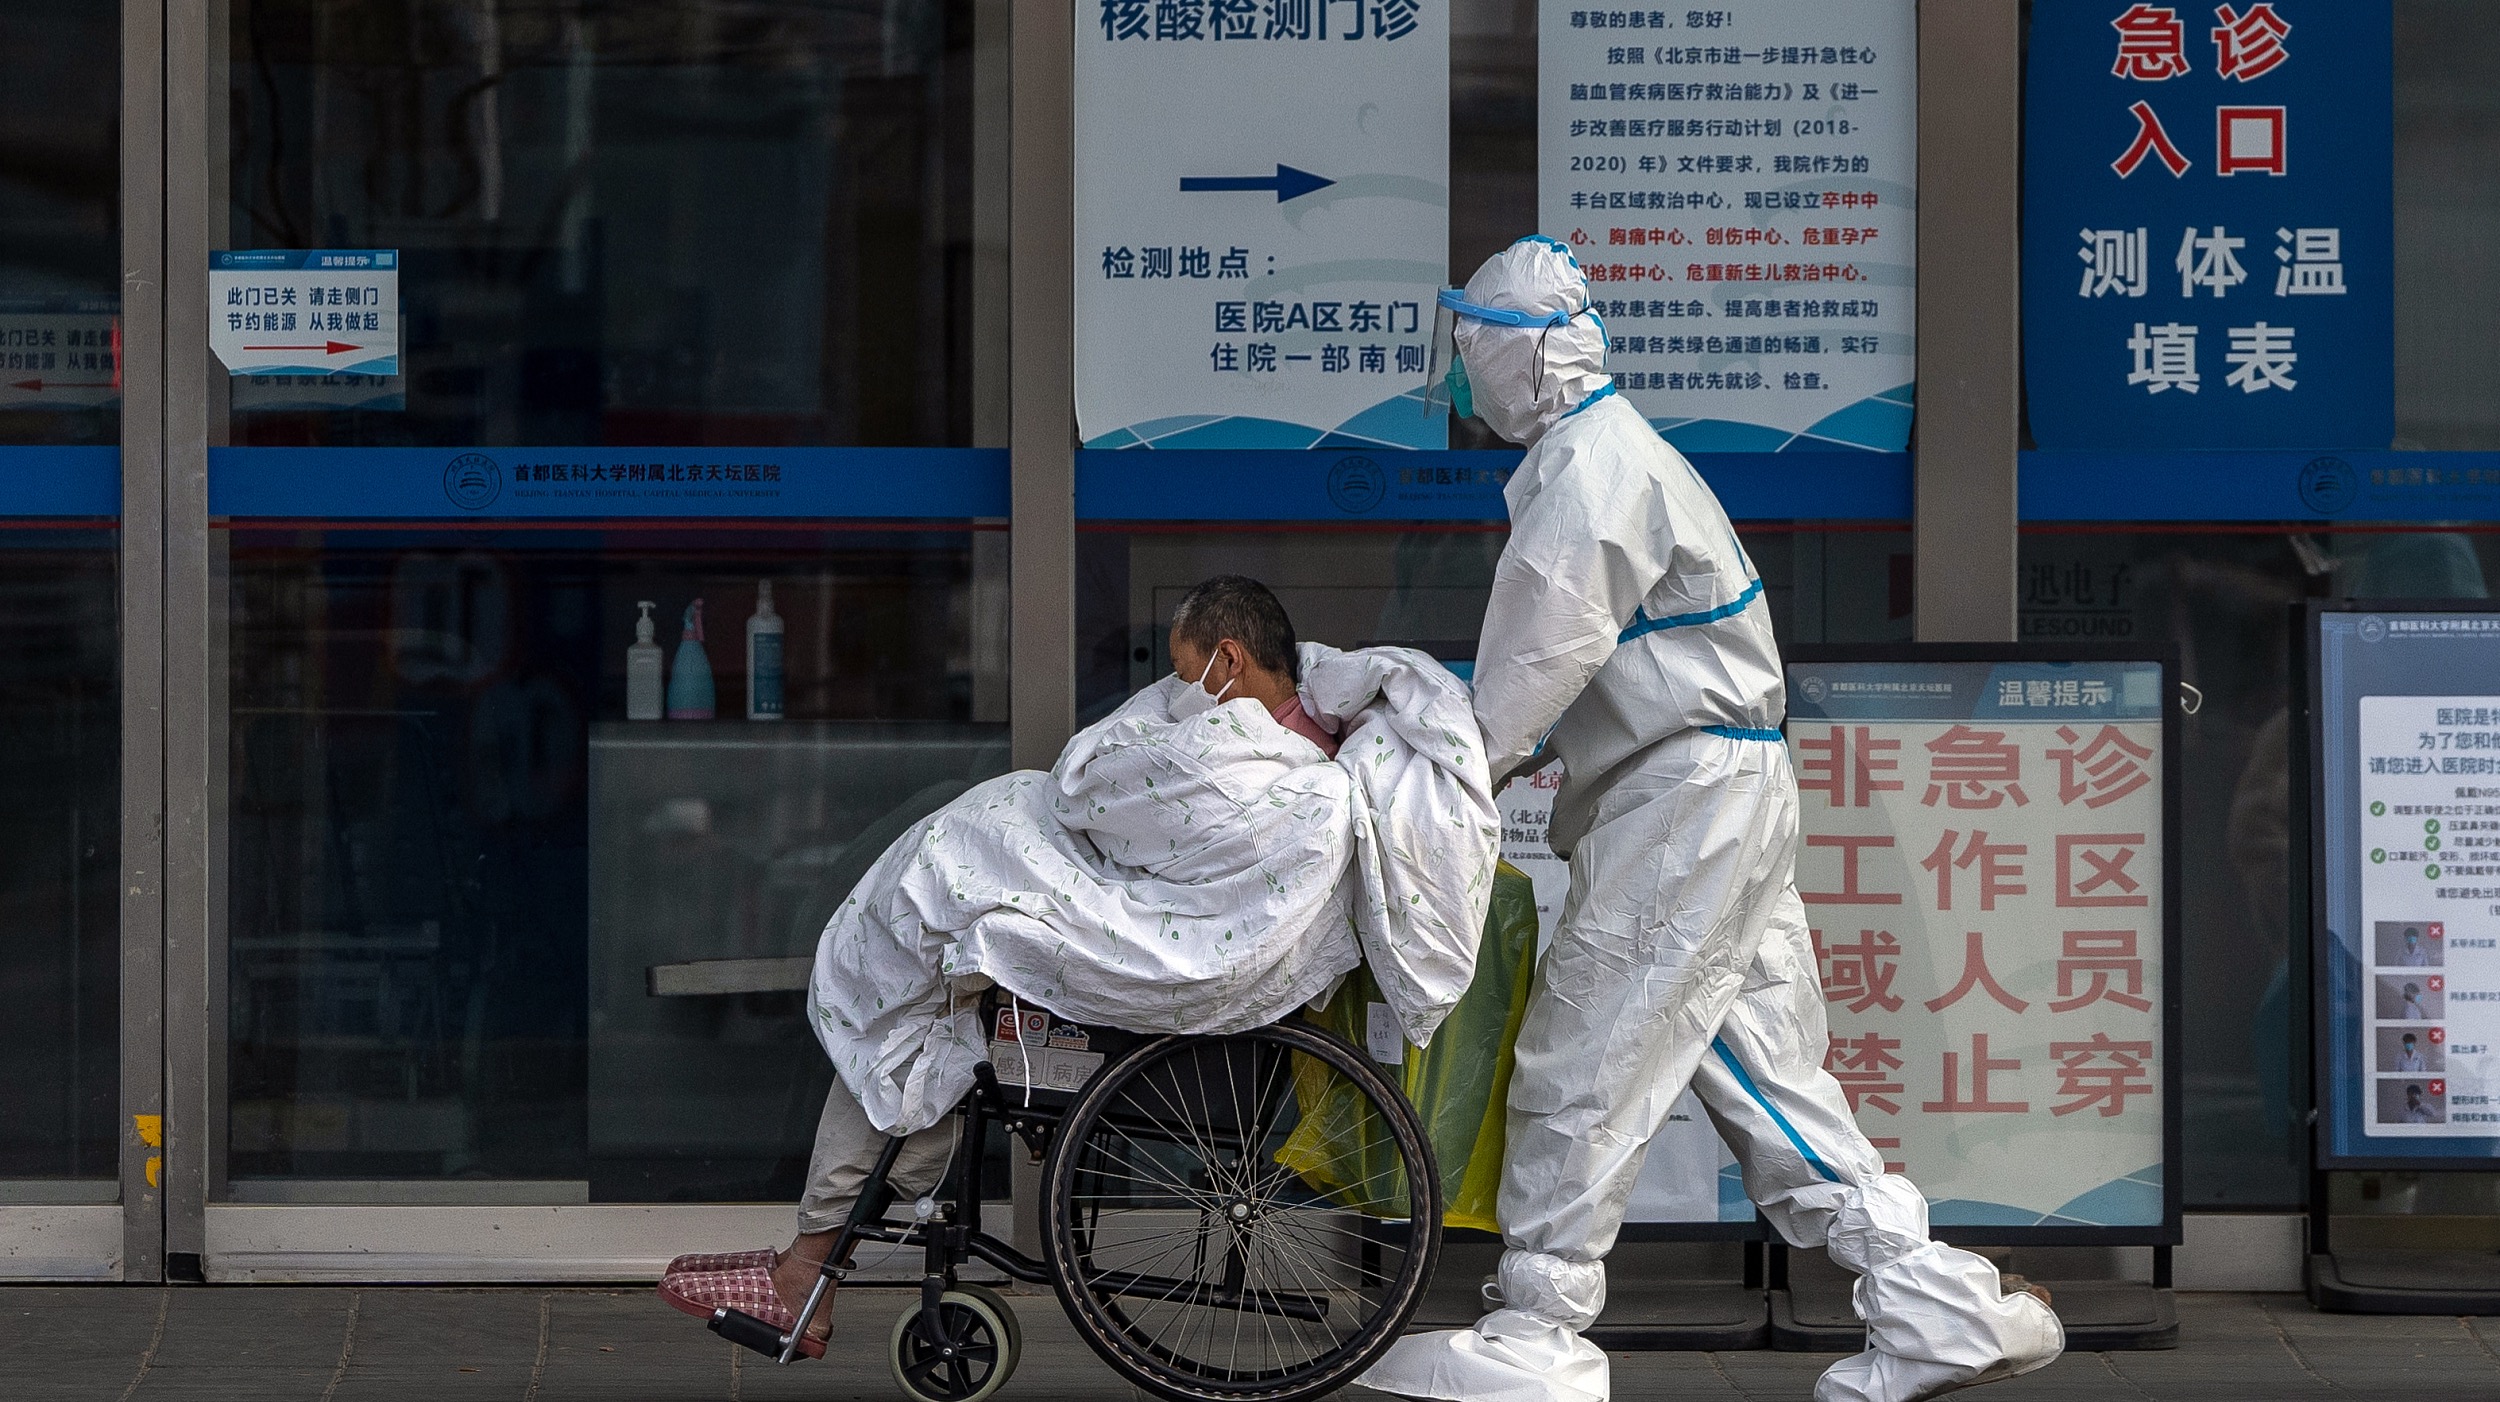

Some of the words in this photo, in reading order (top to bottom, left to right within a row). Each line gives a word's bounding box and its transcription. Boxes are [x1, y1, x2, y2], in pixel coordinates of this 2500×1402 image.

[1100, 0, 1421, 41] 核酸检测门诊
[1570, 11, 1733, 28] 尊敬的患者，您好！
[1608, 47, 1877, 65] 按照《北京市进一步提升急性心
[2110, 3, 2292, 82] 急诊
[1570, 83, 1878, 101] 脑血管疾病医疗救治能力》及《进一
[2110, 100, 2287, 179] 入口
[1570, 191, 1878, 210] 丰台区域救治中心，现已设立卒中中
[1570, 228, 1878, 246] 心、胸痛中心、创伤中心、危重孕产
[1102, 246, 1275, 279] 检测地点：
[2078, 226, 2347, 298] 测体温
[227, 287, 297, 306] 此门已关
[309, 287, 379, 306] 请走侧门
[227, 312, 297, 331] 节约能源
[309, 312, 379, 331] 从我做起
[1215, 301, 1418, 333] 医院A区东门
[1211, 342, 1425, 373] 住院一部南侧
[2127, 322, 2297, 394] 填表
[1600, 372, 1829, 390] 通道患者优先就诊、检查。
[513, 464, 782, 483] 首都医科大学附属北京天坛医院
[1998, 680, 2108, 707] 温馨提示
[1799, 725, 2154, 810] 非急诊
[2369, 757, 2500, 775] 请您进入医院时
[1800, 828, 2149, 911] 工作区
[1809, 930, 2153, 1015] 域人员
[1824, 1032, 2153, 1118] 禁止穿
